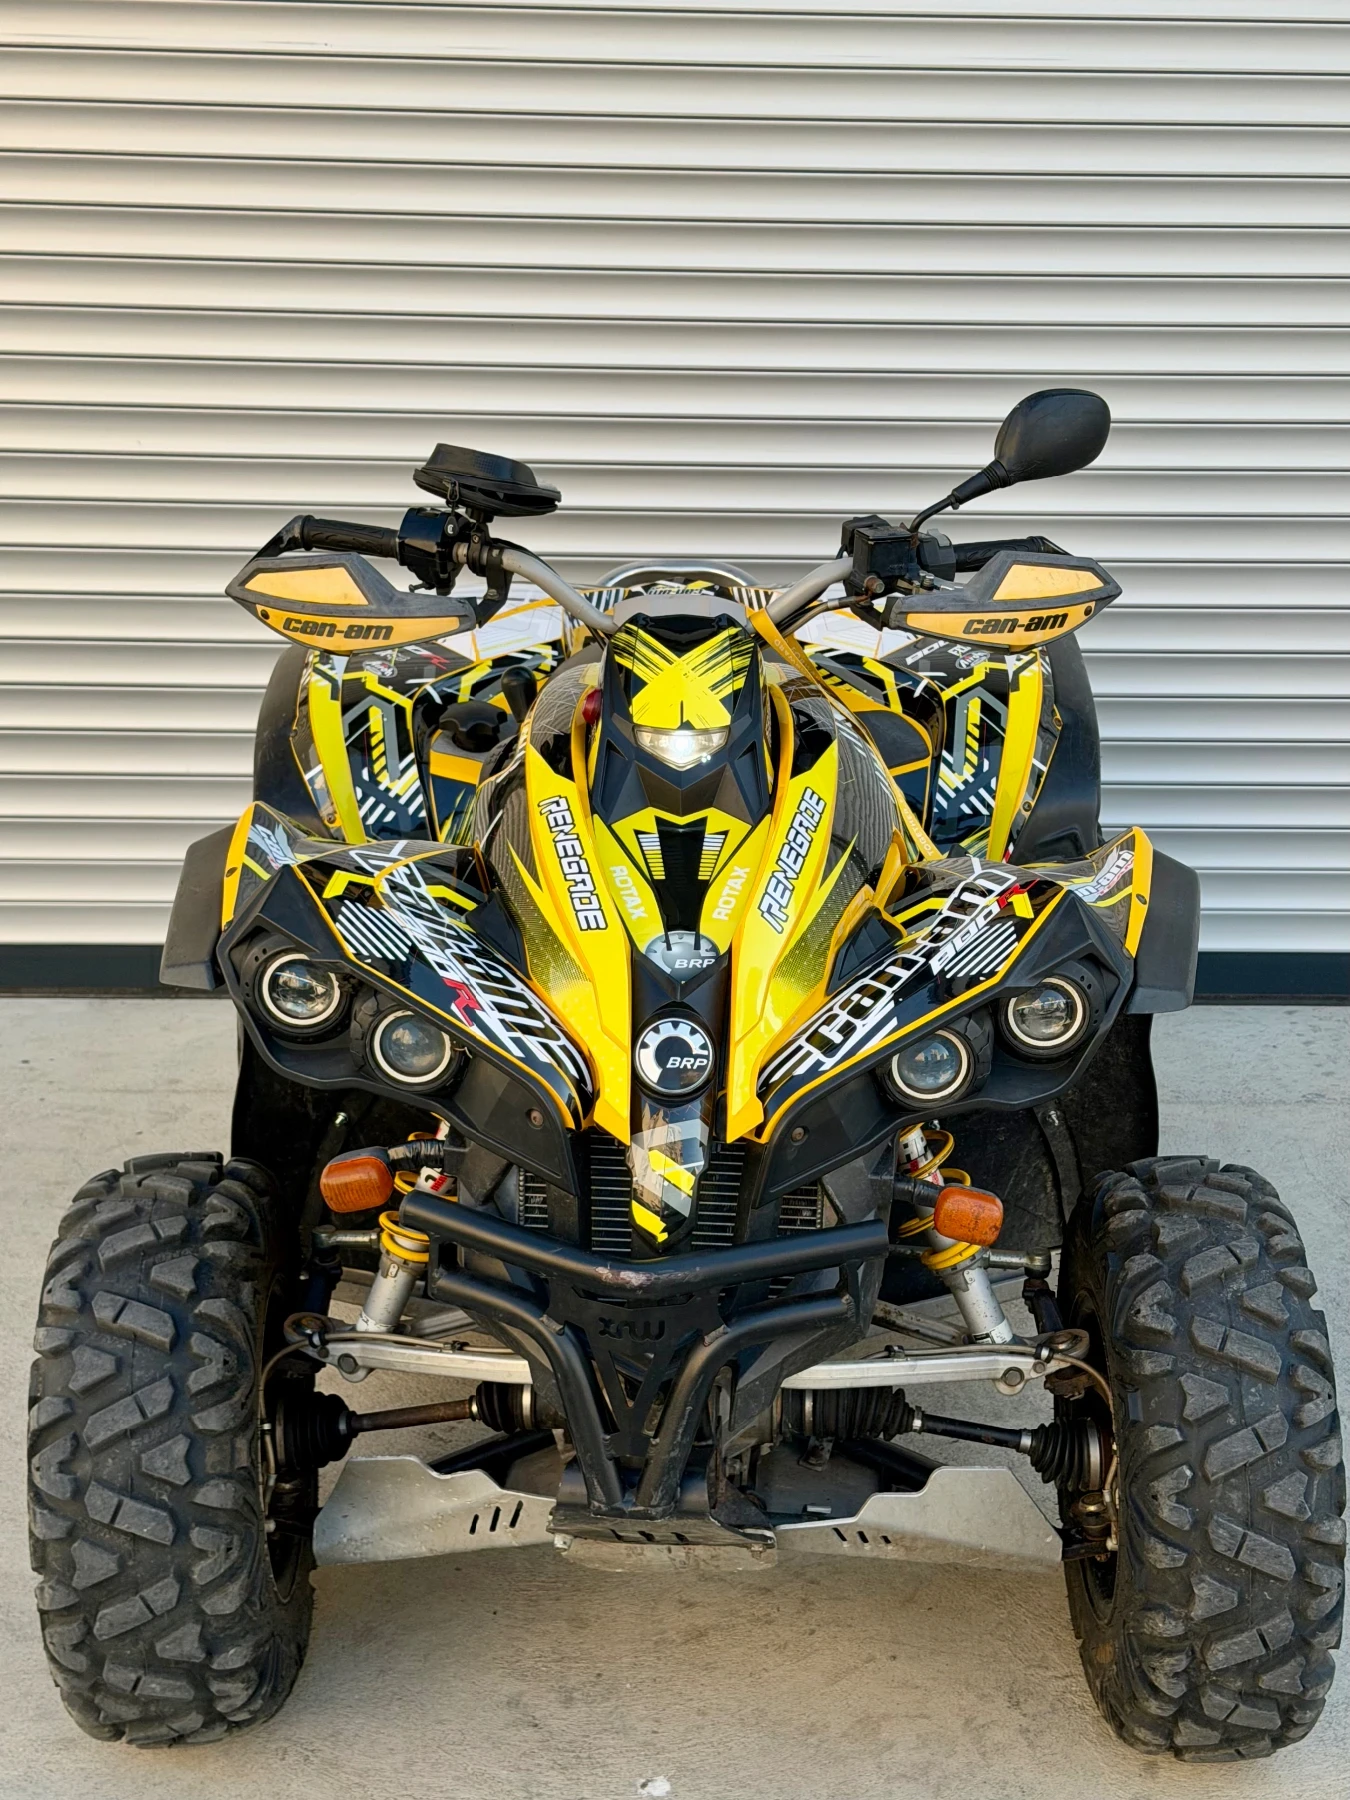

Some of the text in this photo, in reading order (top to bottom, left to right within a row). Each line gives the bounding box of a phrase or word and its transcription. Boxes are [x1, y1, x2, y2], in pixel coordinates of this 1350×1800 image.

[282, 617, 394, 641] can-am
[962, 612, 1069, 635] can-am
[537, 795, 609, 932] RENEGADE
[756, 786, 827, 934] RENEGADE
[608, 864, 649, 922] ROTAX
[712, 865, 751, 922] ROTAX
[928, 877, 1040, 977] 800R
[673, 957, 717, 970] BRP
[801, 868, 1018, 1064] can-am
[665, 1056, 708, 1070] BRP
